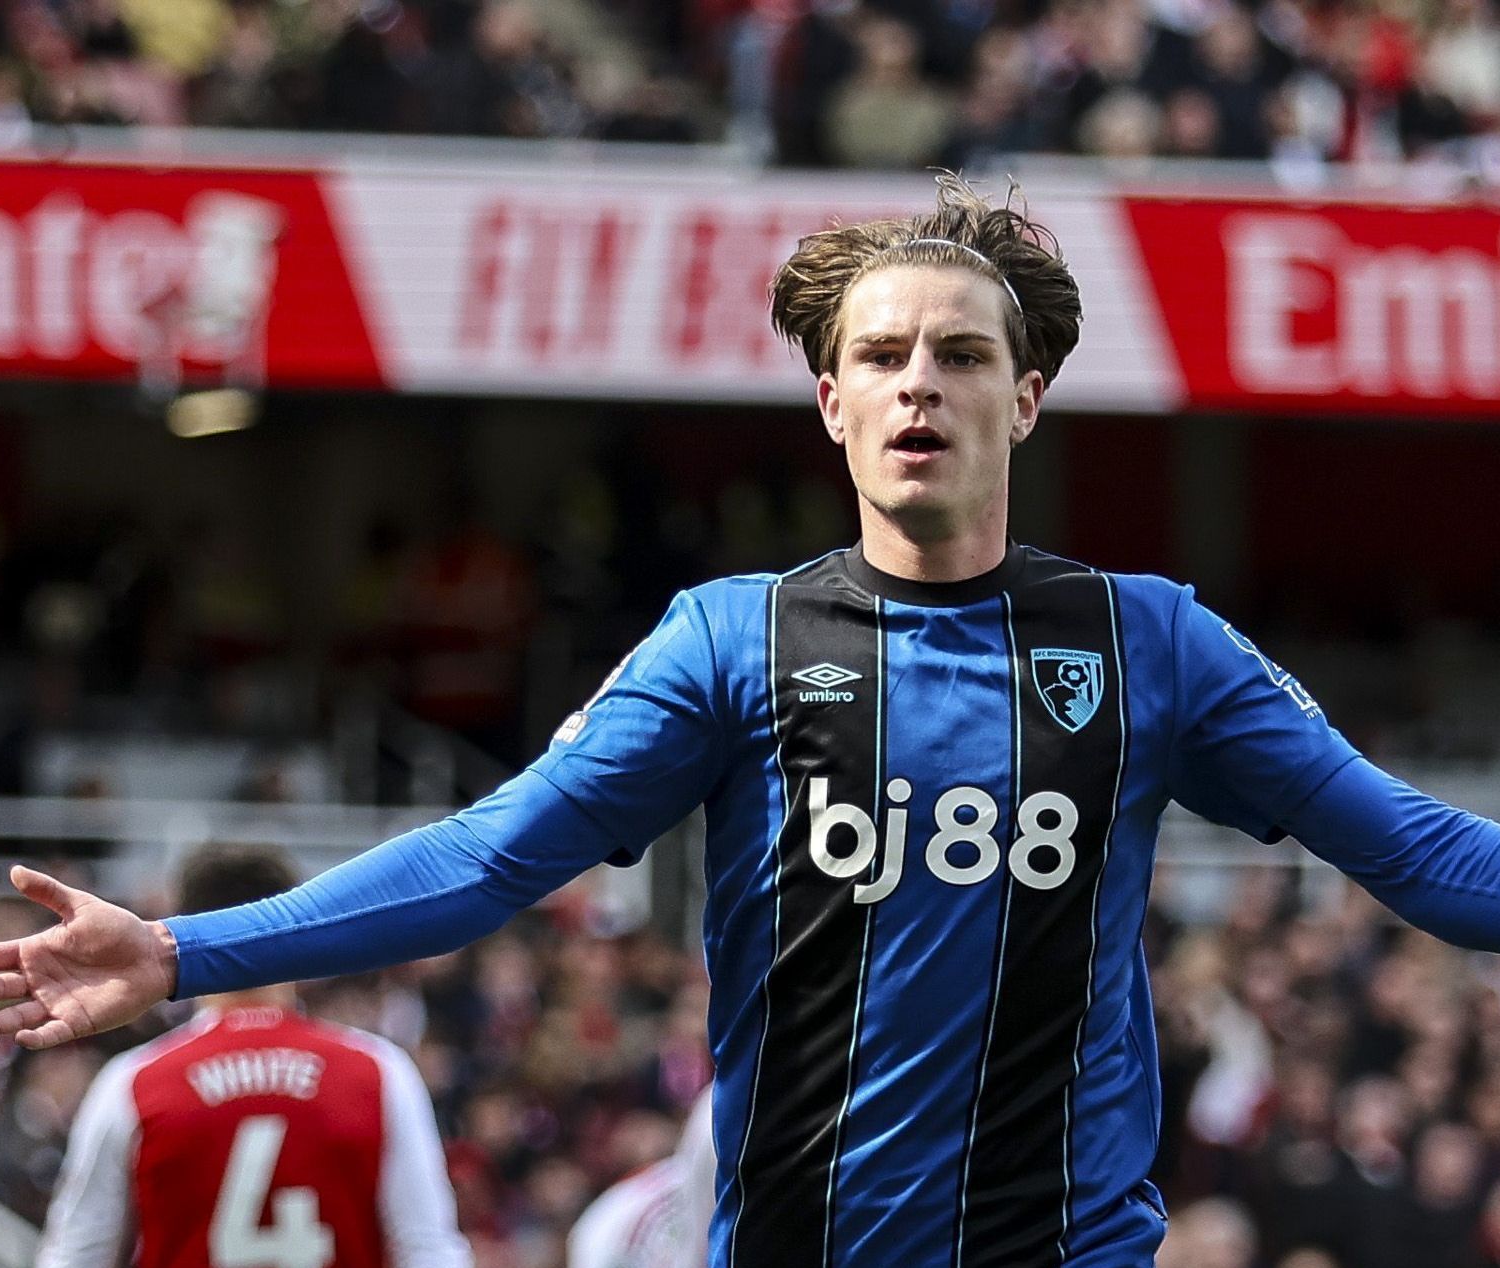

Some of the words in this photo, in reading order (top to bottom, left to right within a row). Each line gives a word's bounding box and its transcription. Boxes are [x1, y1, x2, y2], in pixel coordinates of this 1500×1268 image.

[457, 203, 645, 354] FLY
[799, 689, 855, 702] umbro
[808, 777, 1078, 903] bj88
[186, 1047, 327, 1106] WHITE
